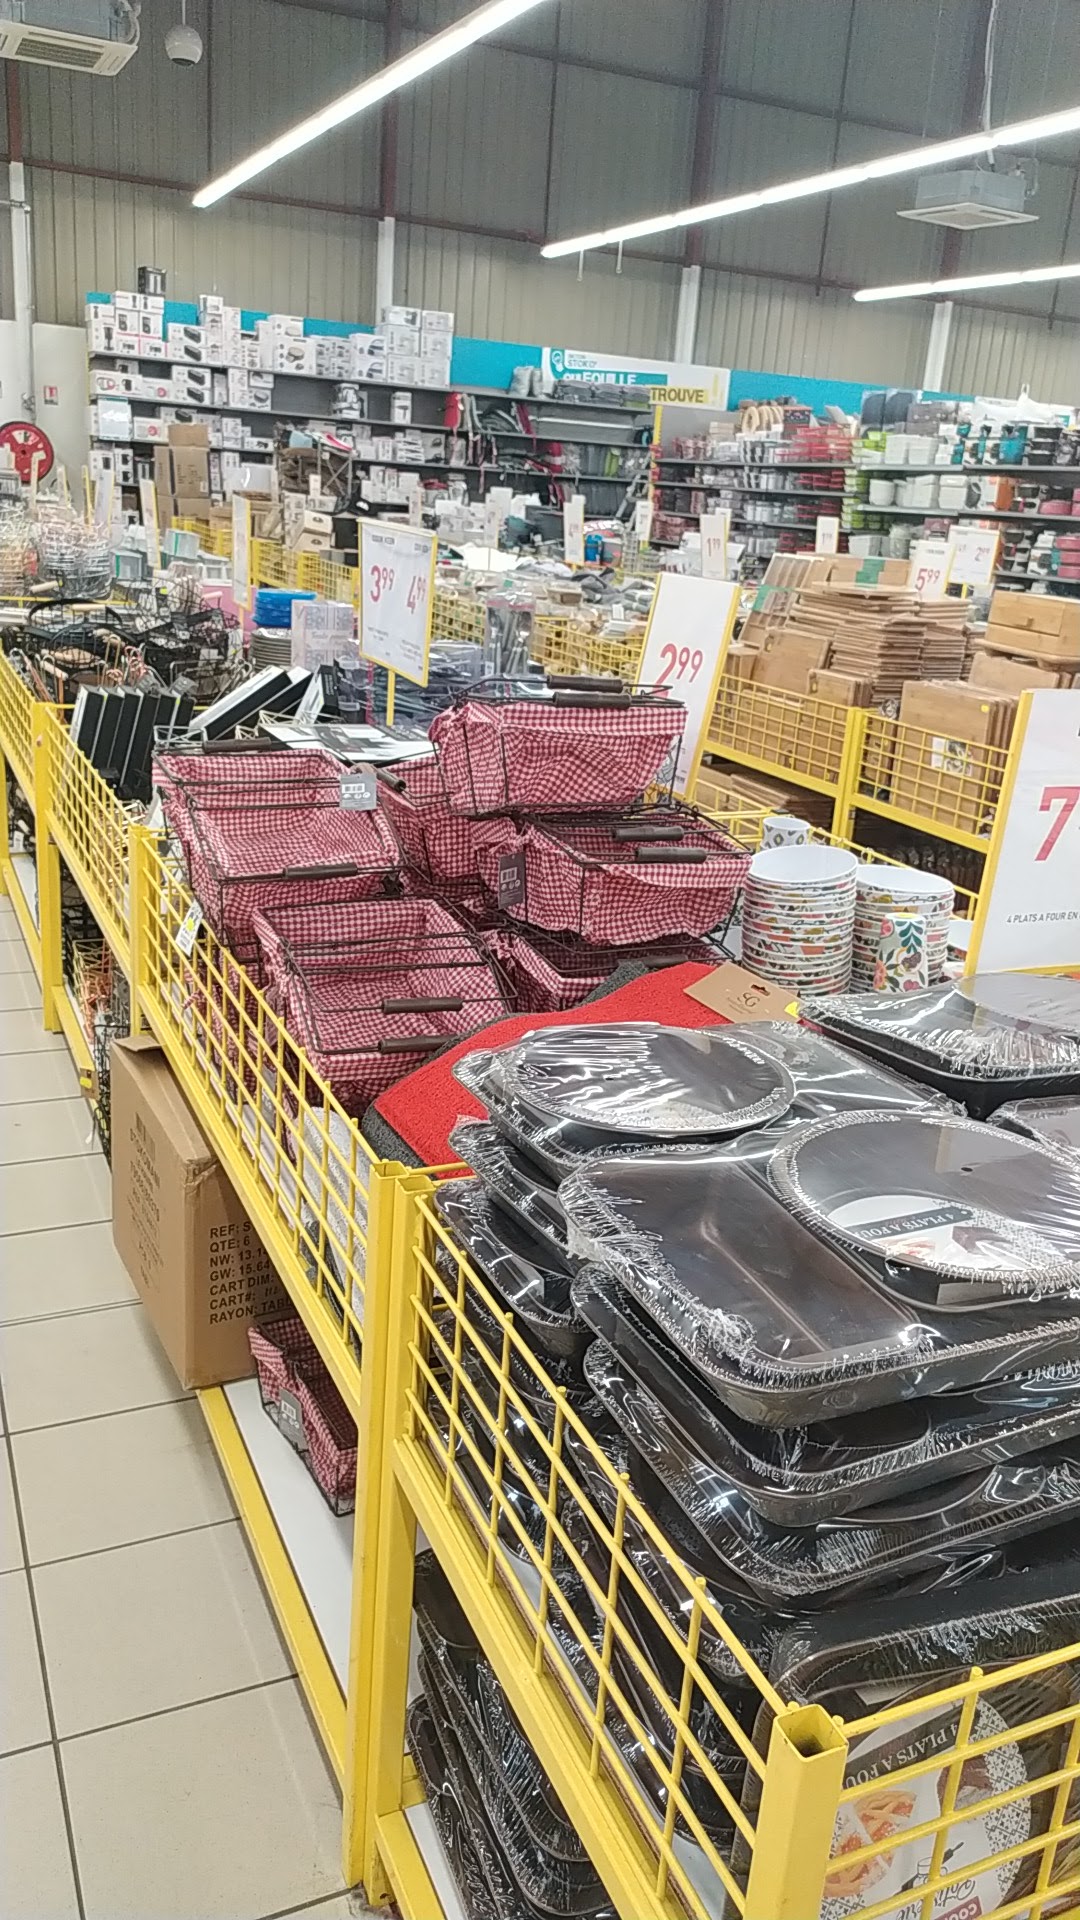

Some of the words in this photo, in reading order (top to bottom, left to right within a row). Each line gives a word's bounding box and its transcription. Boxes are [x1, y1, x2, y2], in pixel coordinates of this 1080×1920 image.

[651, 387, 704, 404] TROUVE
[1013, 913, 1038, 923] PLATS
[1038, 913, 1044, 922] A
[1046, 912, 1067, 921] FOUR
[1067, 911, 1079, 920] EN
[889, 1223, 902, 1232] A
[902, 1214, 947, 1230] PLATS
[210, 1224, 240, 1239] REF:
[210, 1239, 240, 1253] QTE:
[210, 1254, 235, 1267] NW:
[210, 1268, 236, 1281] GW:
[210, 1279, 245, 1296] CART
[210, 1292, 256, 1310] CART#:
[210, 1306, 258, 1325] RAYON:
[896, 1728, 949, 1765] PLATS
[881, 1755, 894, 1771] A
[845, 1762, 878, 1790] FOU
